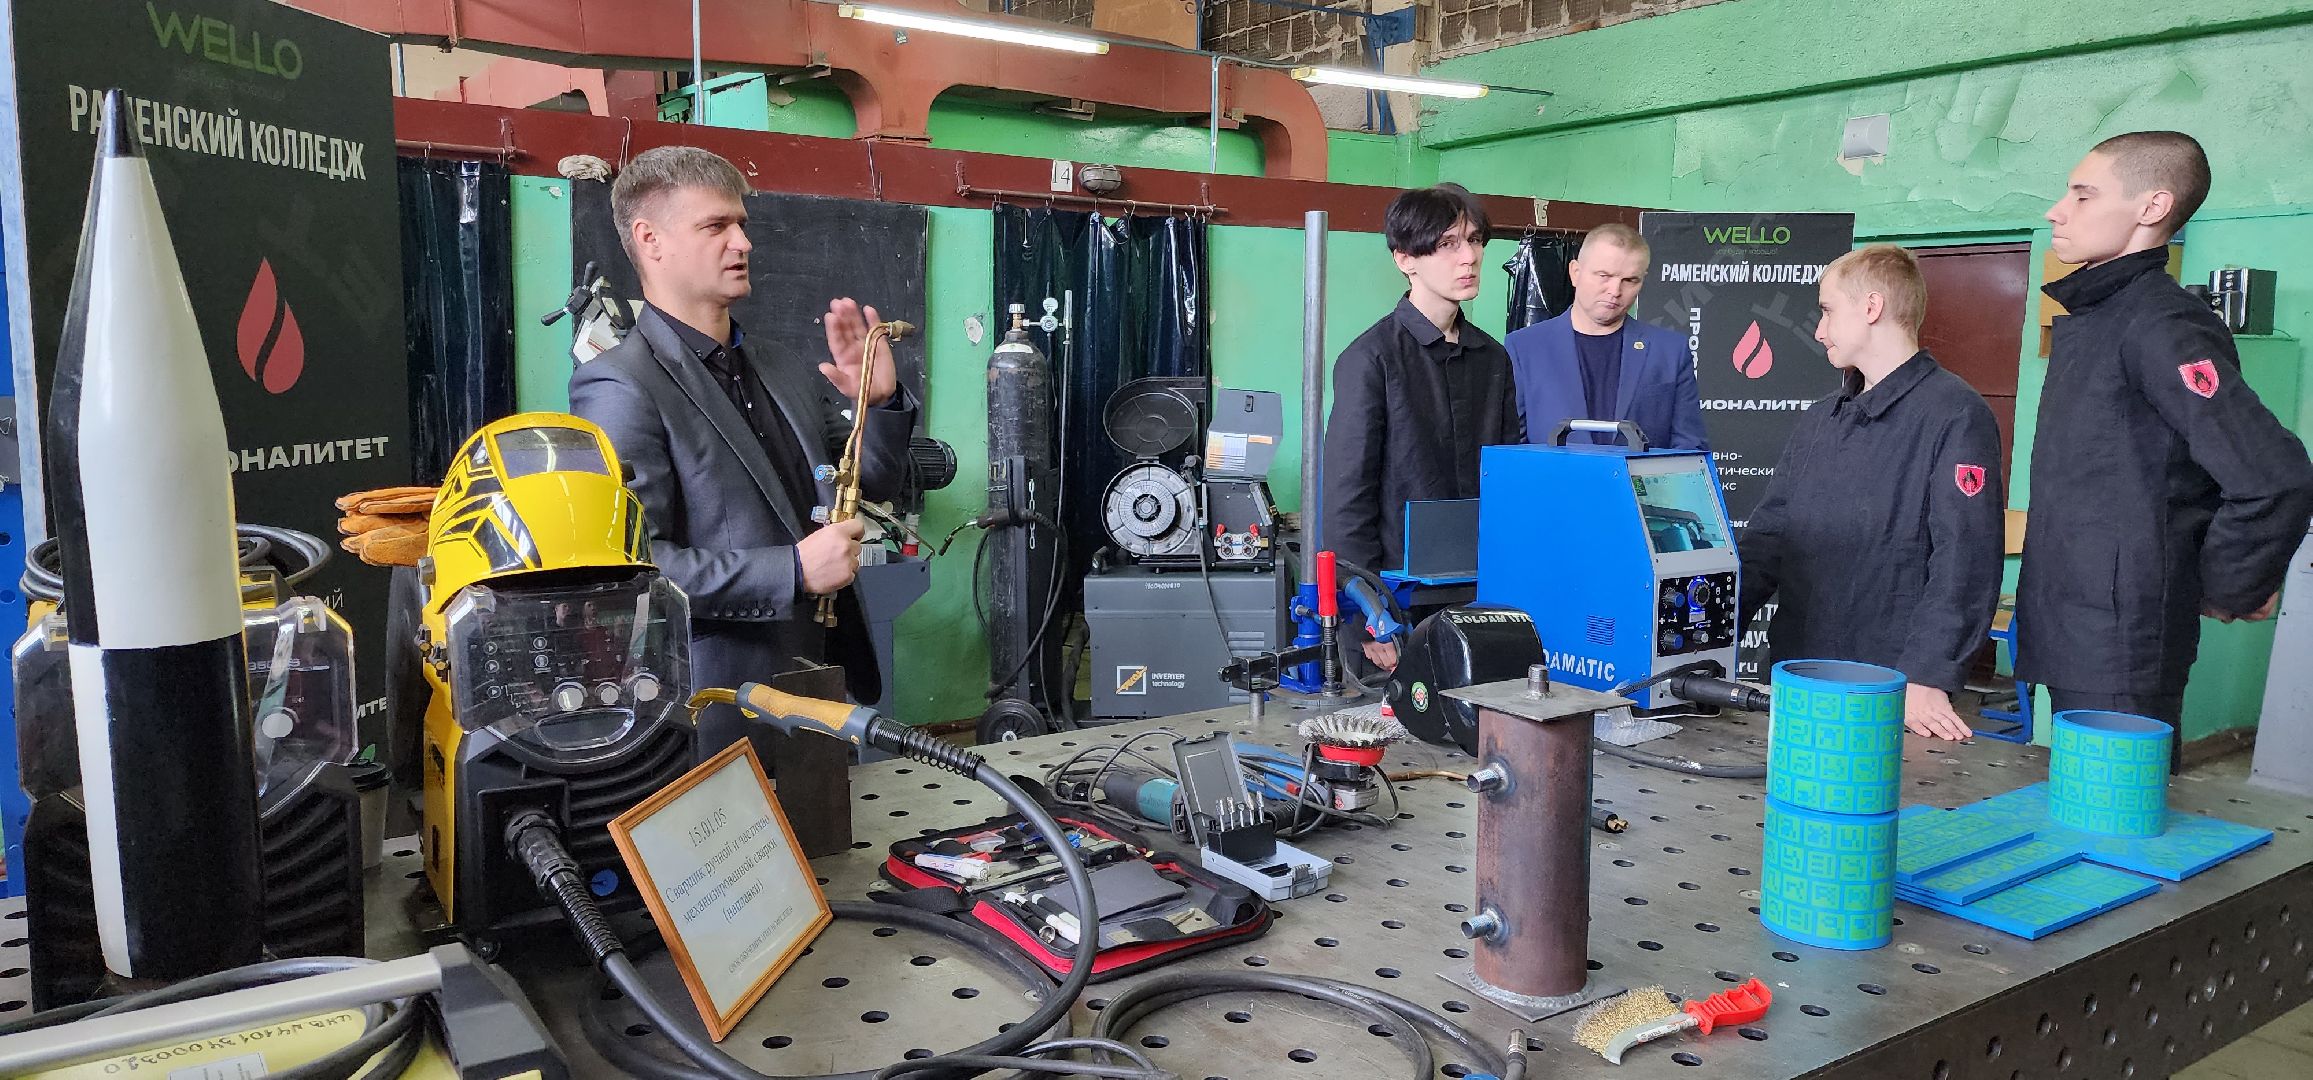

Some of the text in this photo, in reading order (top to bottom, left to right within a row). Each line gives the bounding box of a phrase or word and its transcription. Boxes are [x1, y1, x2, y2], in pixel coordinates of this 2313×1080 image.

[147, 2, 304, 80] WELLO
[249, 120, 367, 182] КОЛЛЕДЖ
[1052, 161, 1071, 185] 14
[1703, 226, 1791, 245] WELLO
[1661, 261, 1828, 285] РАМЕНСКИЙ КОЛЛЕДЖ
[1699, 399, 1815, 411] ИОНАЛИТЕ
[1717, 467, 1775, 477] тически
[1151, 672, 1185, 680] INVERTER
[688, 808, 728, 848] 15.01.05
[704, 841, 732, 878] ручной
[753, 838, 778, 866] сварки
[722, 879, 765, 924] (наплавки)
